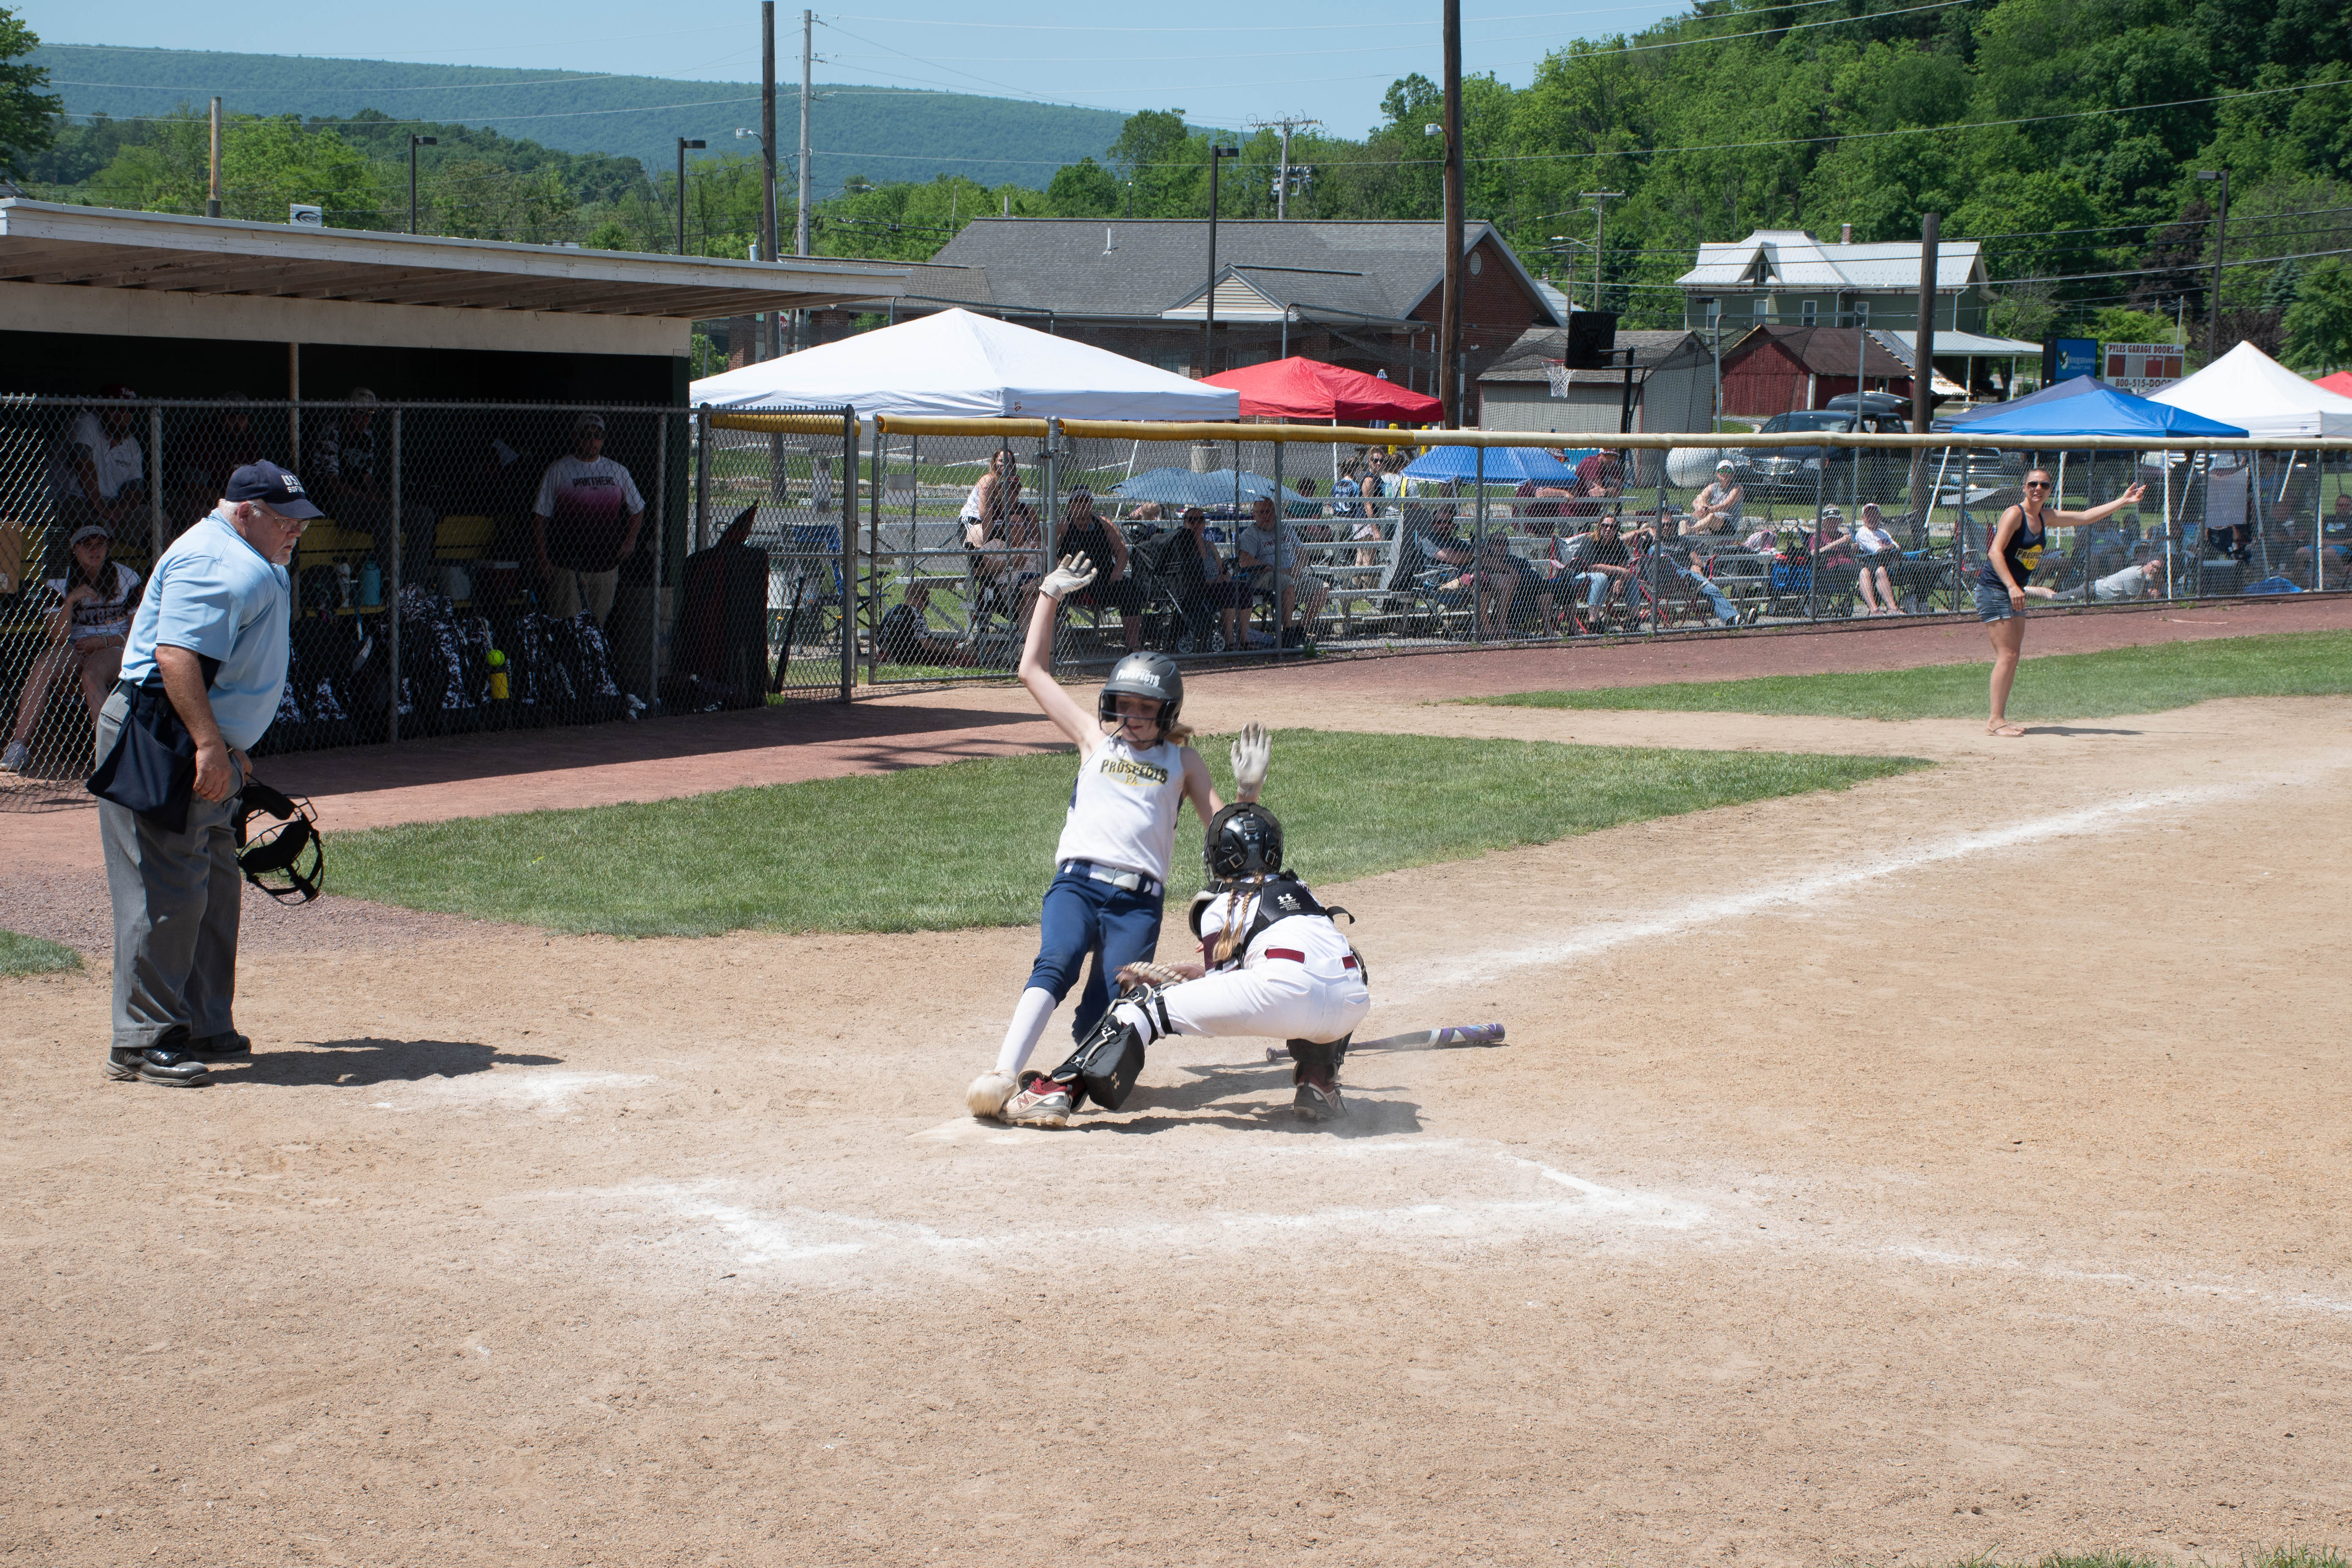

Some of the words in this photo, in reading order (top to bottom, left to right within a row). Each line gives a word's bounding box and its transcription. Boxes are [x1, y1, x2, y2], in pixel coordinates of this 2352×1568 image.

[2128, 345, 2151, 353] GARAGE
[572, 476, 615, 487] PANTHERS
[1100, 759, 1168, 784] PROSPECTS
[1125, 775, 1138, 784] PA
